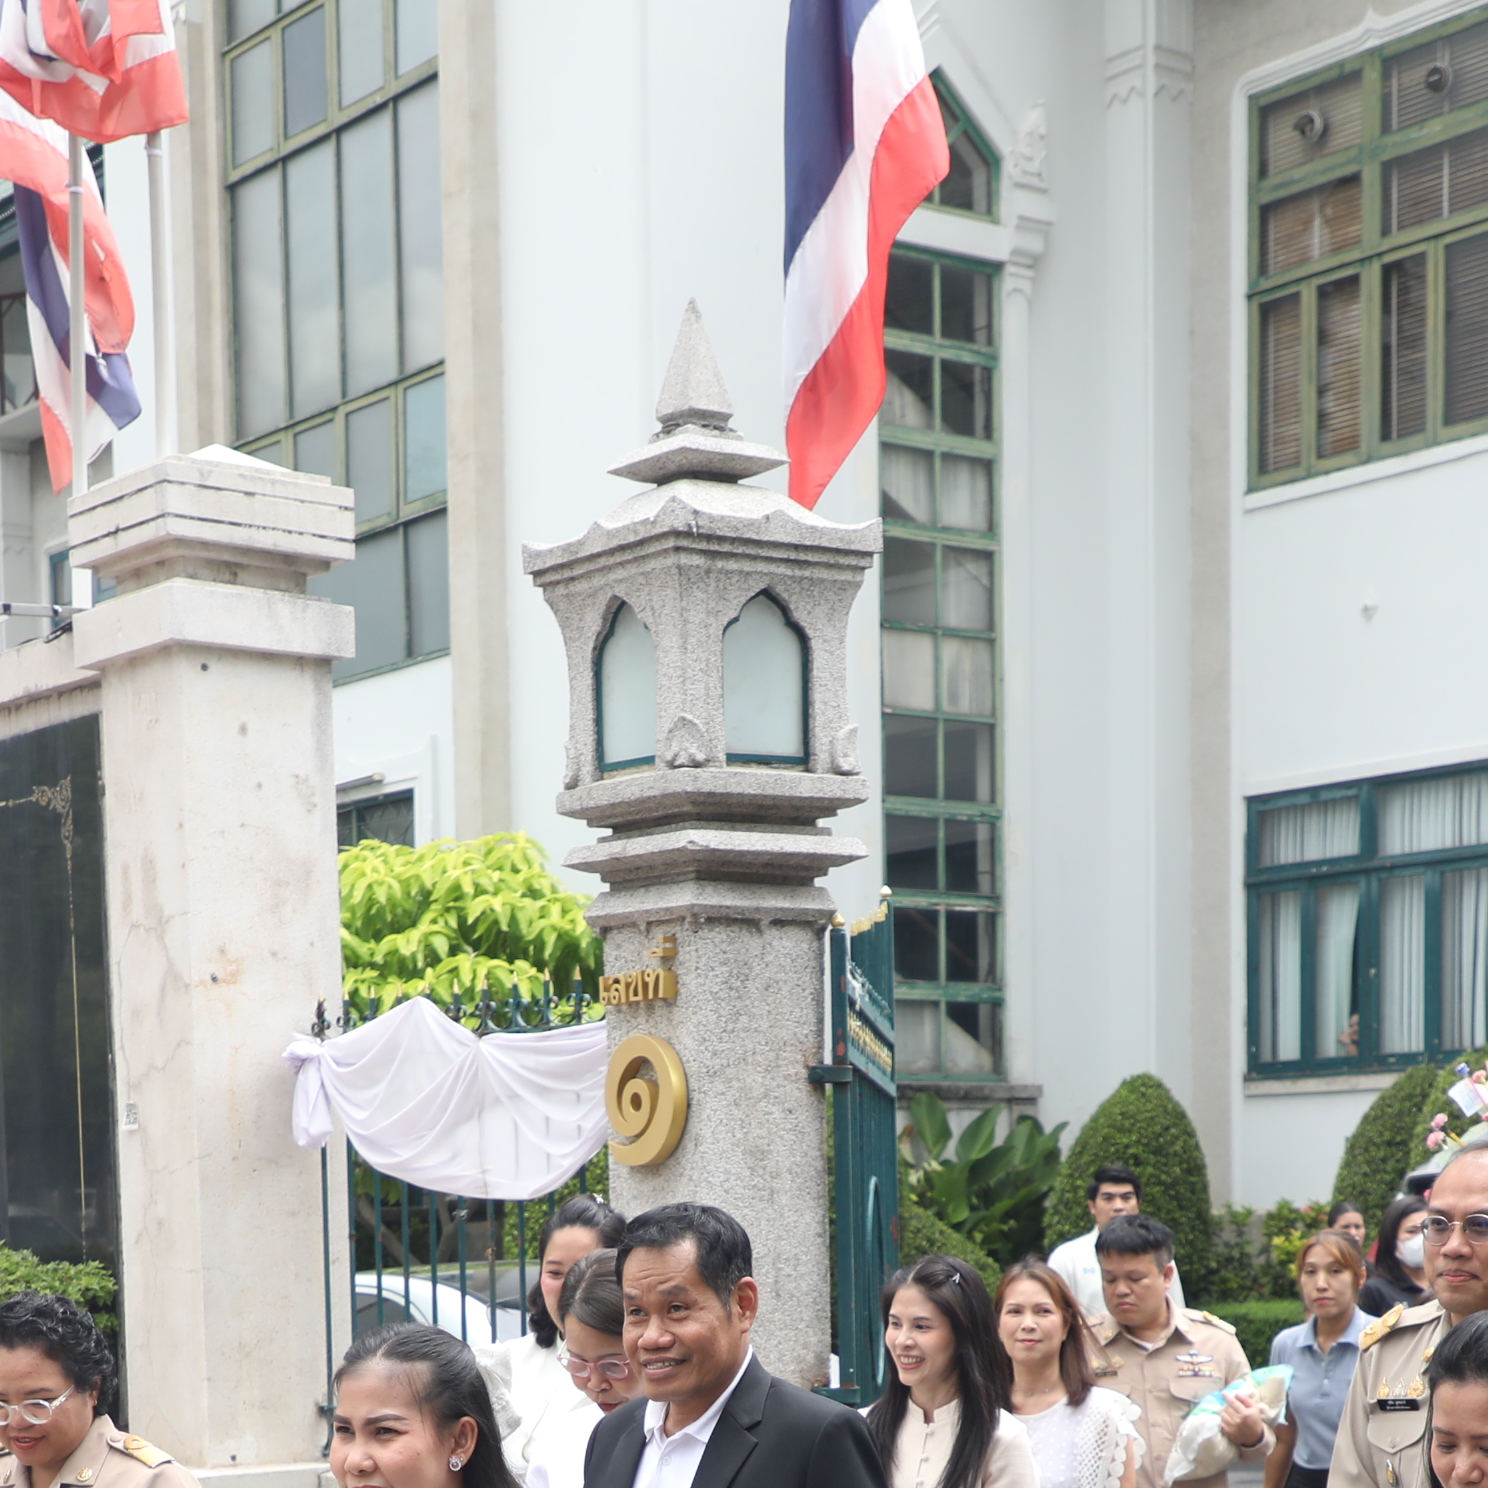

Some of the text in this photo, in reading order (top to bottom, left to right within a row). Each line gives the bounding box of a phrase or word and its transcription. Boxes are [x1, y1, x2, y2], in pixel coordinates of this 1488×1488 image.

[599, 935, 678, 1005] เลขที่
[605, 1034, 689, 1167] ๑
